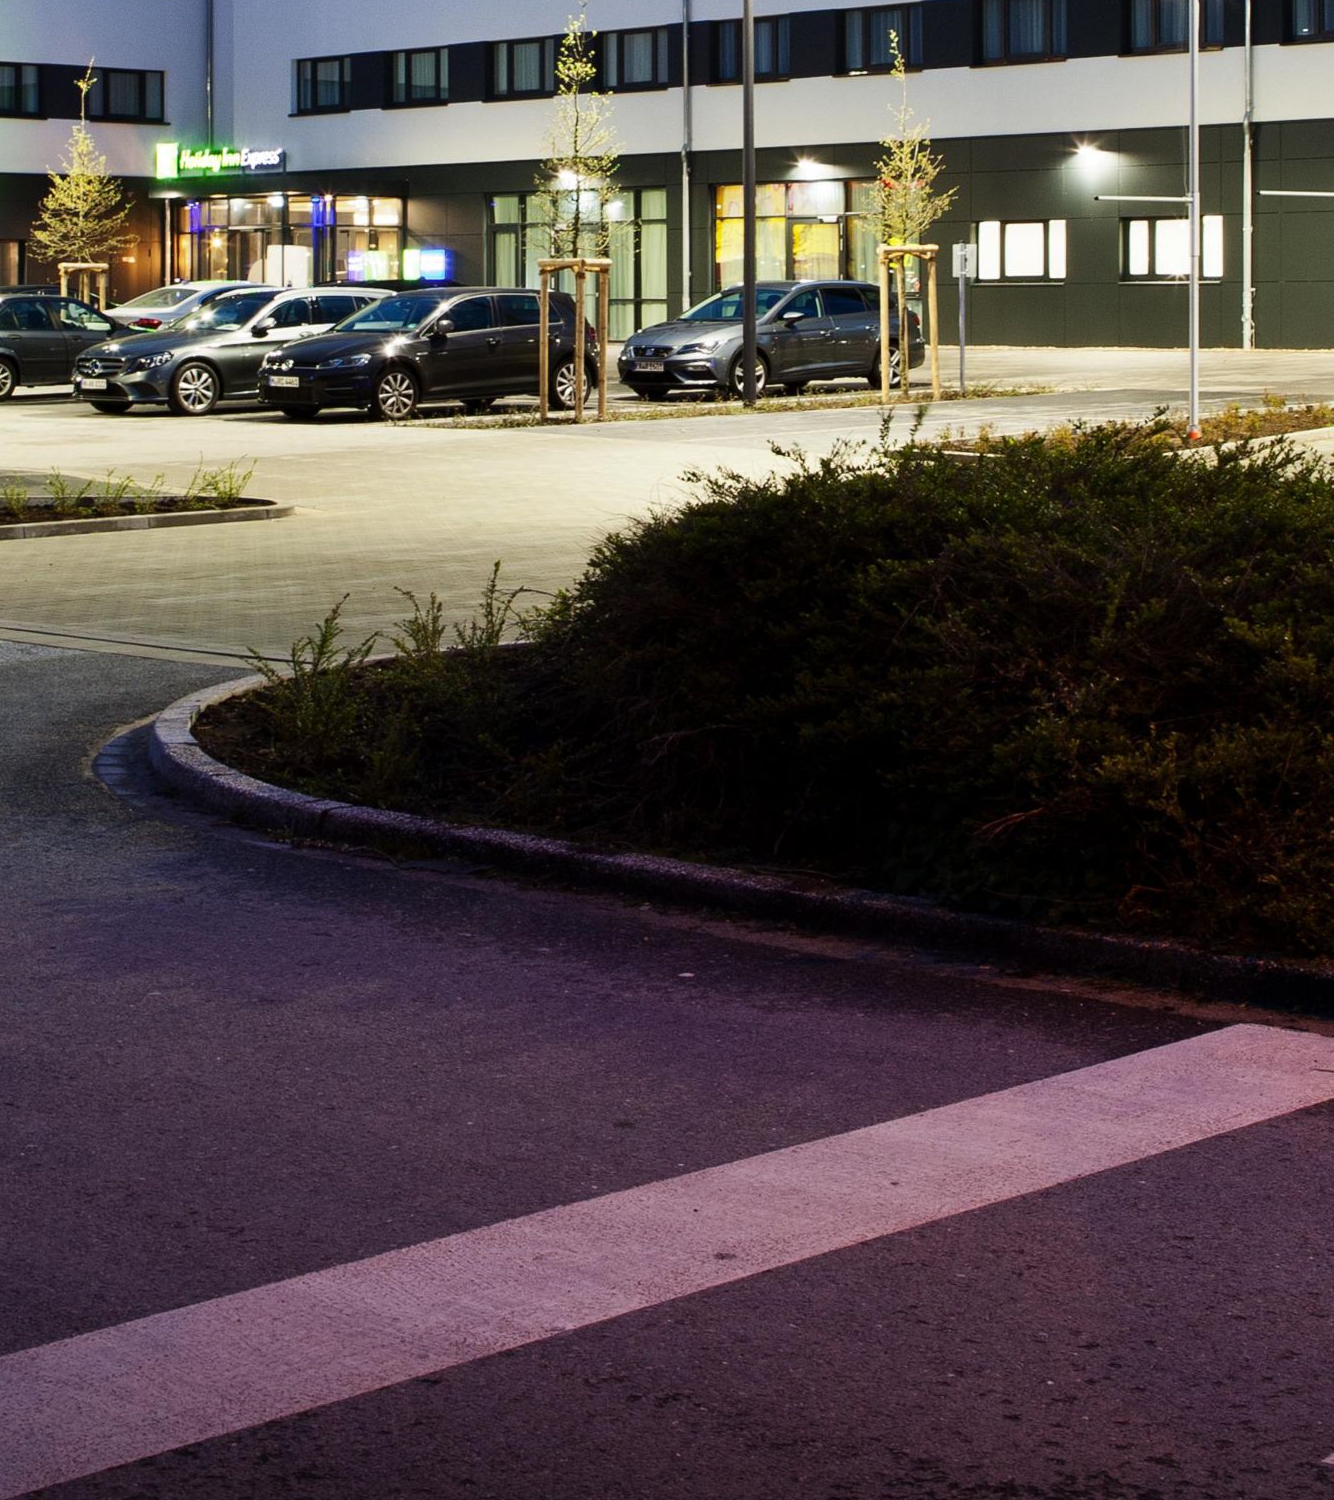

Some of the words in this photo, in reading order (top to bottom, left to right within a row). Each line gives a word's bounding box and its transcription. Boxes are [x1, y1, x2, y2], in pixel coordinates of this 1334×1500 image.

[180, 148, 221, 173] Holiday
[222, 147, 241, 168] Inn
[241, 147, 280, 170] Express
